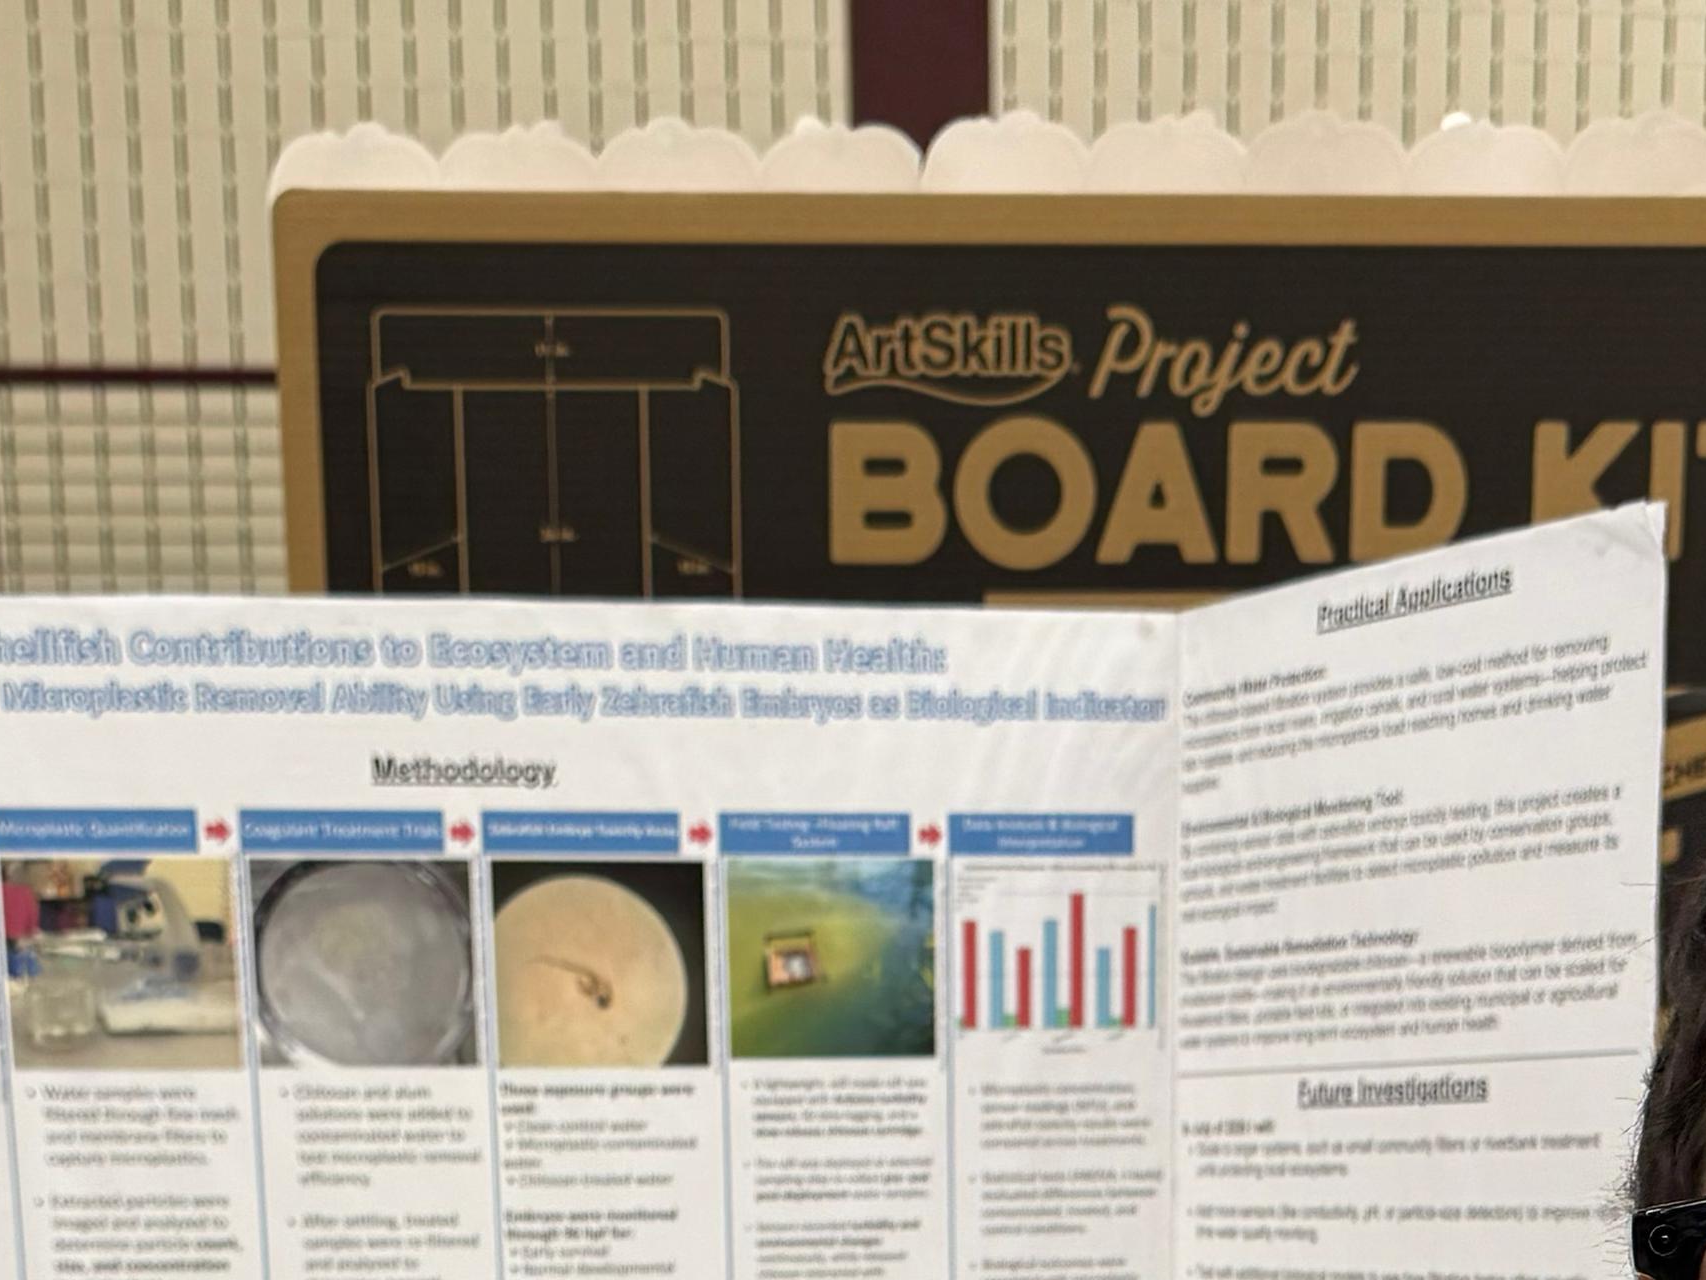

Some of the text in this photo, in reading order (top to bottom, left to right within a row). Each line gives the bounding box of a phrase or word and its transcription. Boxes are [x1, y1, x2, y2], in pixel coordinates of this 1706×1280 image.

[825, 304, 1360, 417] ArtSkills Project
[829, 416, 1467, 570] BOARD
[1317, 567, 1513, 631] Practical Applications
[129, 631, 373, 668] Contributions
[380, 636, 420, 668] to
[427, 633, 611, 674] Ecosystem
[618, 635, 687, 669] and
[694, 637, 816, 672] Human
[823, 636, 947, 674] Health:
[2, 682, 190, 716] Microplastic
[195, 683, 325, 713] Removal
[330, 683, 428, 719] Ability
[521, 687, 595, 722] Early
[598, 687, 734, 719] Zebrafish
[740, 689, 861, 724] Embryos
[869, 695, 901, 719] as
[905, 687, 1037, 724] Biological
[372, 758, 557, 787] Methodology
[1298, 1074, 1488, 1107] Future Investigations
